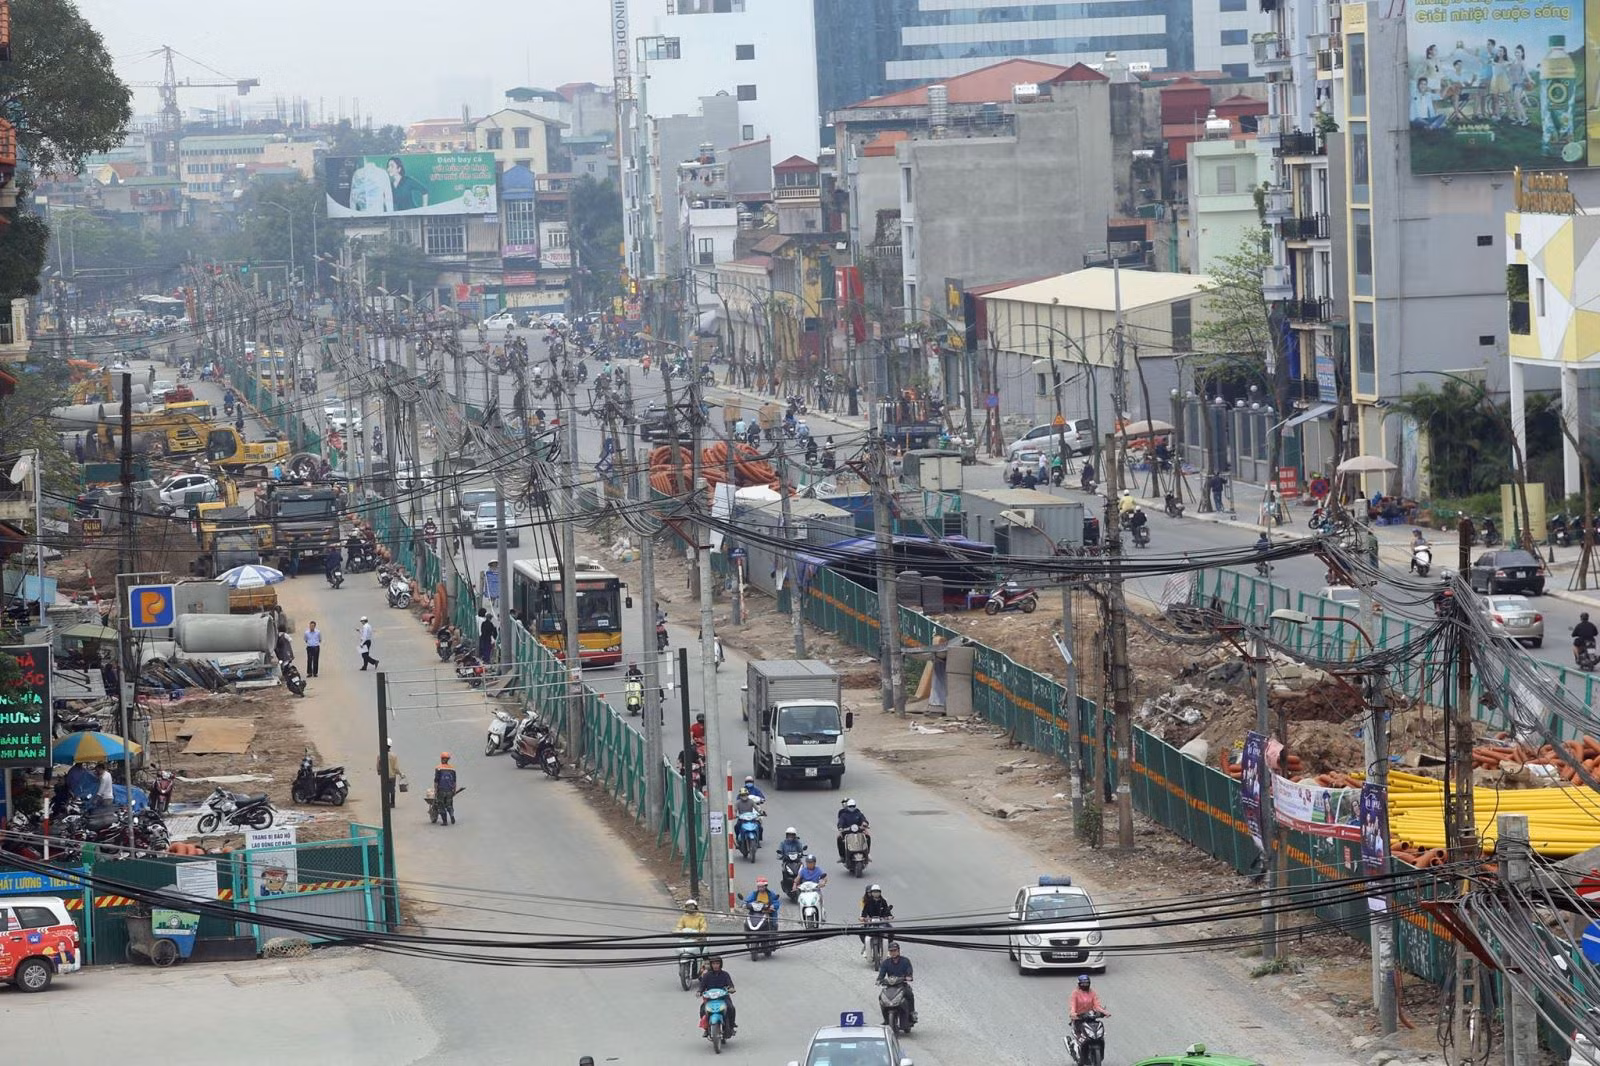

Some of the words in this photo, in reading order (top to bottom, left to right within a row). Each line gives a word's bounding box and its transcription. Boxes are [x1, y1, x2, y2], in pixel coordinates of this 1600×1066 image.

[1415, 7, 1447, 23] Giải
[1451, 7, 1488, 24] nhiệt
[1492, 5, 1530, 23] cuộc
[1535, 2, 1569, 21] sống
